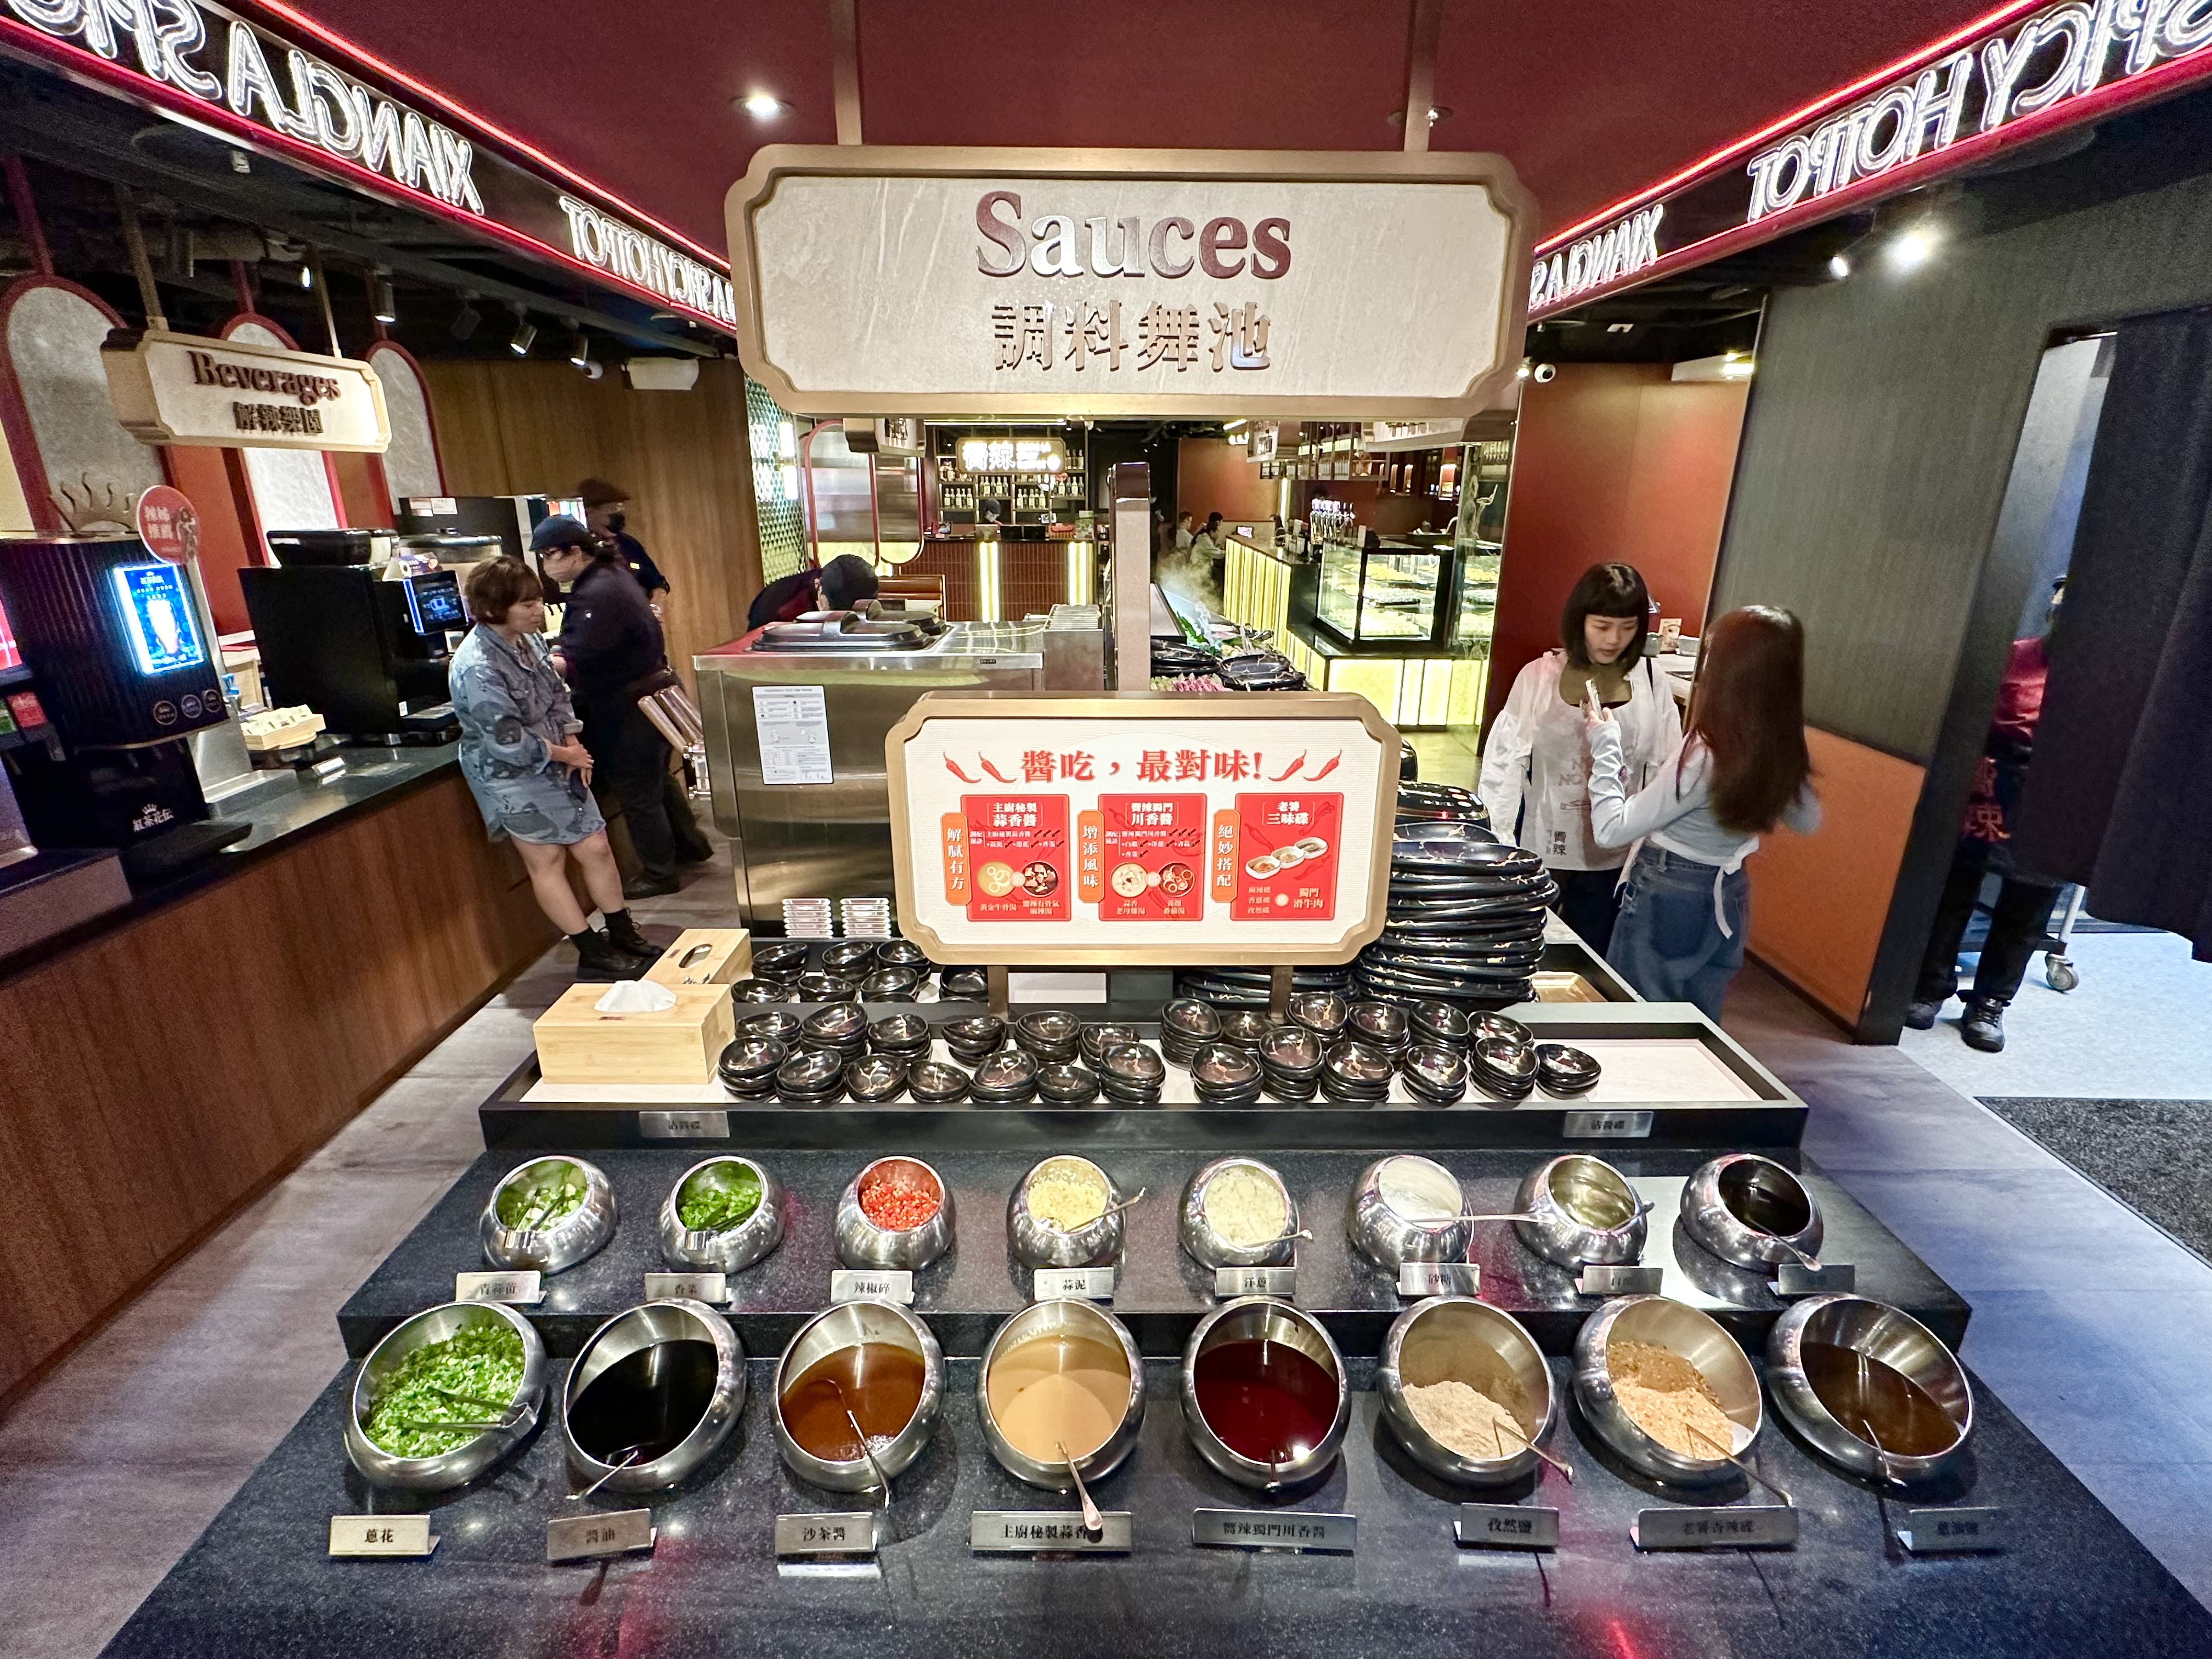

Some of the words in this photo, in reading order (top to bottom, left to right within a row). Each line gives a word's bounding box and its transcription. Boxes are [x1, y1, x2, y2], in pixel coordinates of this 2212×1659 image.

[976, 190, 1291, 279] Sauces
[992, 299, 1271, 372] 調料舞池
[187, 351, 341, 405] Beverages
[992, 813, 1037, 827] 蒜香醬
[1131, 812, 1173, 826] 川香醬
[1266, 812, 1310, 825] 三味碟
[947, 828, 965, 890] 解膩有方
[1082, 826, 1099, 888] 增添風味
[1216, 824, 1234, 887] 絕妙搭配
[1299, 888, 1319, 898] 獨門
[1293, 899, 1324, 909] 滑牛肉
[854, 1282, 890, 1294] 辣椒碎
[1063, 1279, 1086, 1290] 蒜泥
[1001, 1524, 1090, 1539] 主廚秘製蒜香
[1488, 1517, 1532, 1534] 孜然鹽
[365, 1528, 393, 1543] 蔥花
[803, 1526, 845, 1542] 沙茶醬
